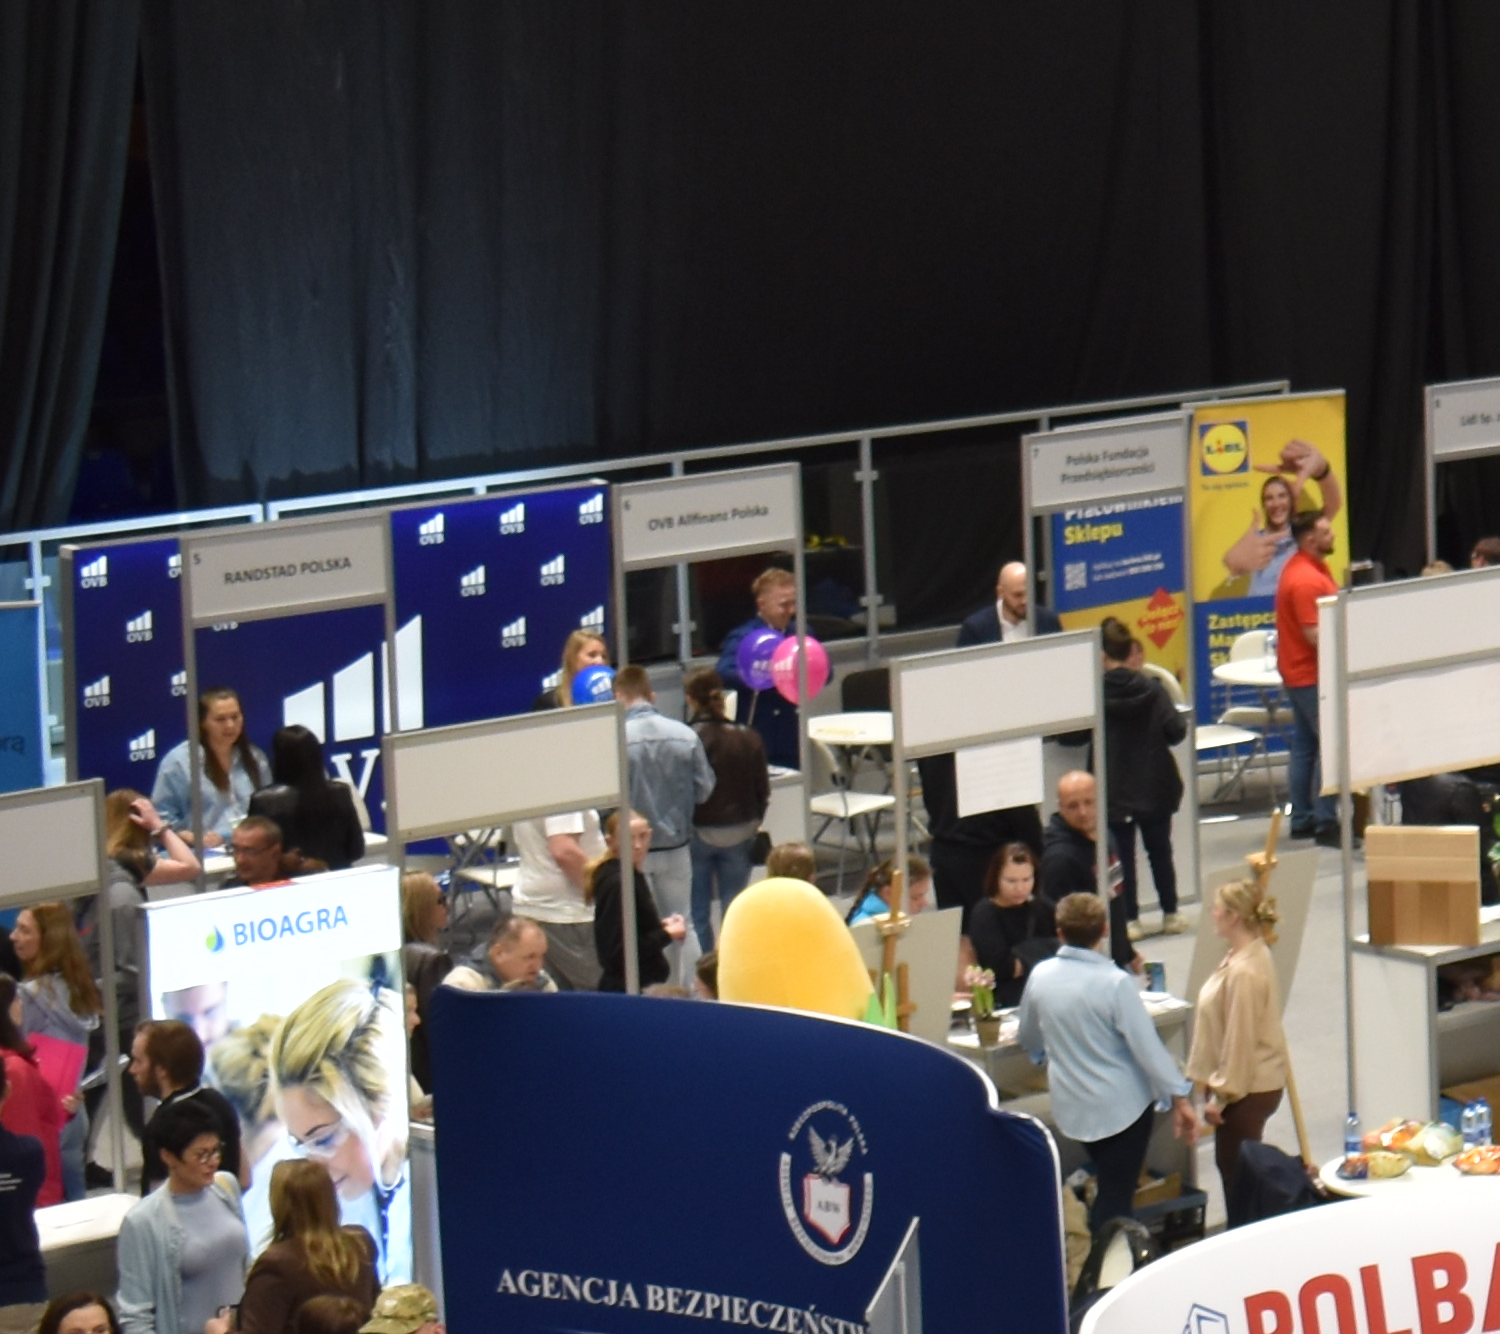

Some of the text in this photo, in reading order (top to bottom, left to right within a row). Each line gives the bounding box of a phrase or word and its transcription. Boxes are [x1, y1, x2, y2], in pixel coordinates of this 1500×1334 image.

[580, 512, 603, 526] OVB
[648, 517, 675, 532] OVB
[731, 504, 770, 521] Polska
[500, 522, 526, 535] OVB
[1064, 523, 1124, 545] Sklepu
[419, 533, 445, 545] OVB
[224, 556, 352, 586] RANDSTAD POLSKA
[81, 577, 108, 589] OVB
[541, 574, 565, 586] OVB
[462, 585, 485, 597] OVB
[127, 630, 153, 643] OVB
[502, 636, 526, 648] OVB
[84, 695, 110, 708] OVB
[129, 749, 155, 762] OVB
[233, 906, 348, 947] BIOAGRA
[498, 1268, 640, 1311] AGENCJA
